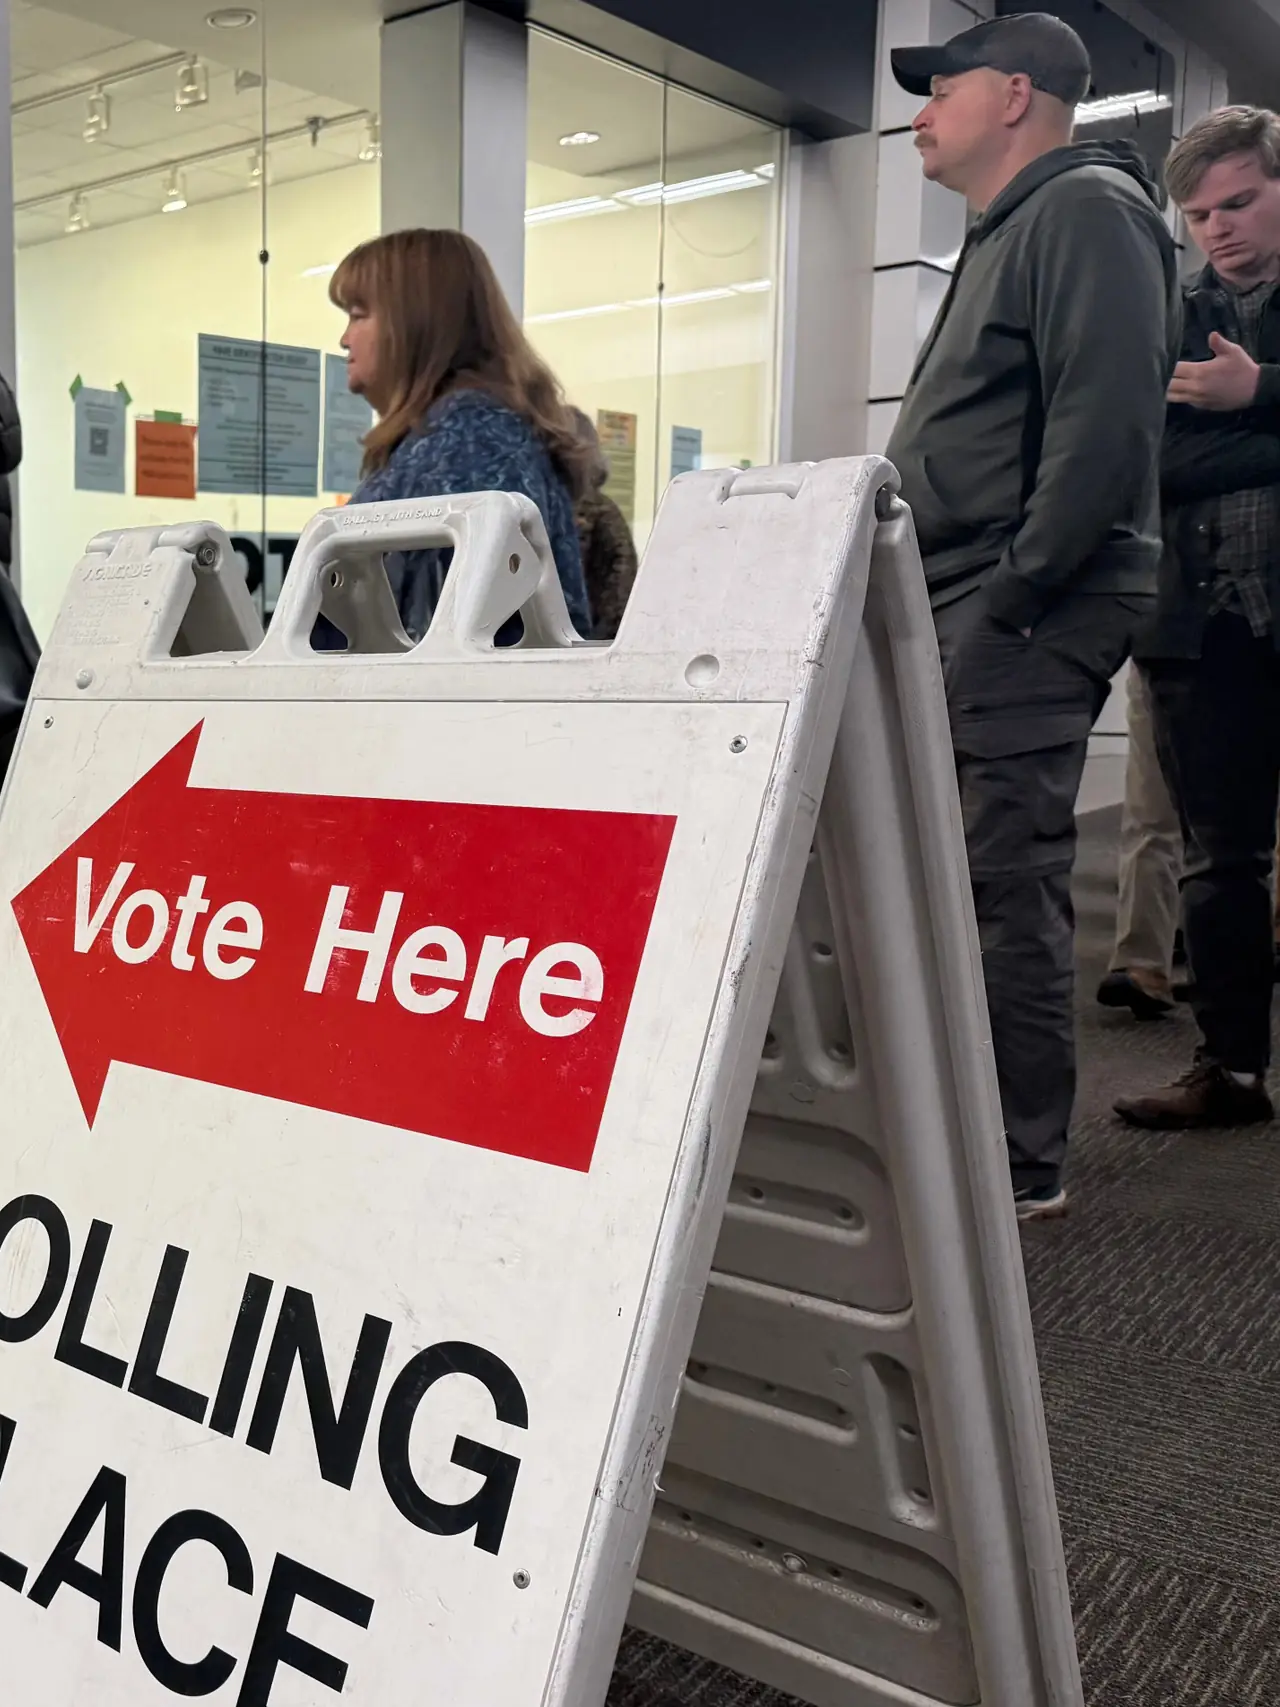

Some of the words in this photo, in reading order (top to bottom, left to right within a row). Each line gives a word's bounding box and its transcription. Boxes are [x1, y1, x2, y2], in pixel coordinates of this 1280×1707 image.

[415, 507, 442, 520] SAND
[73, 856, 264, 981] Vote
[303, 884, 604, 1038] Here
